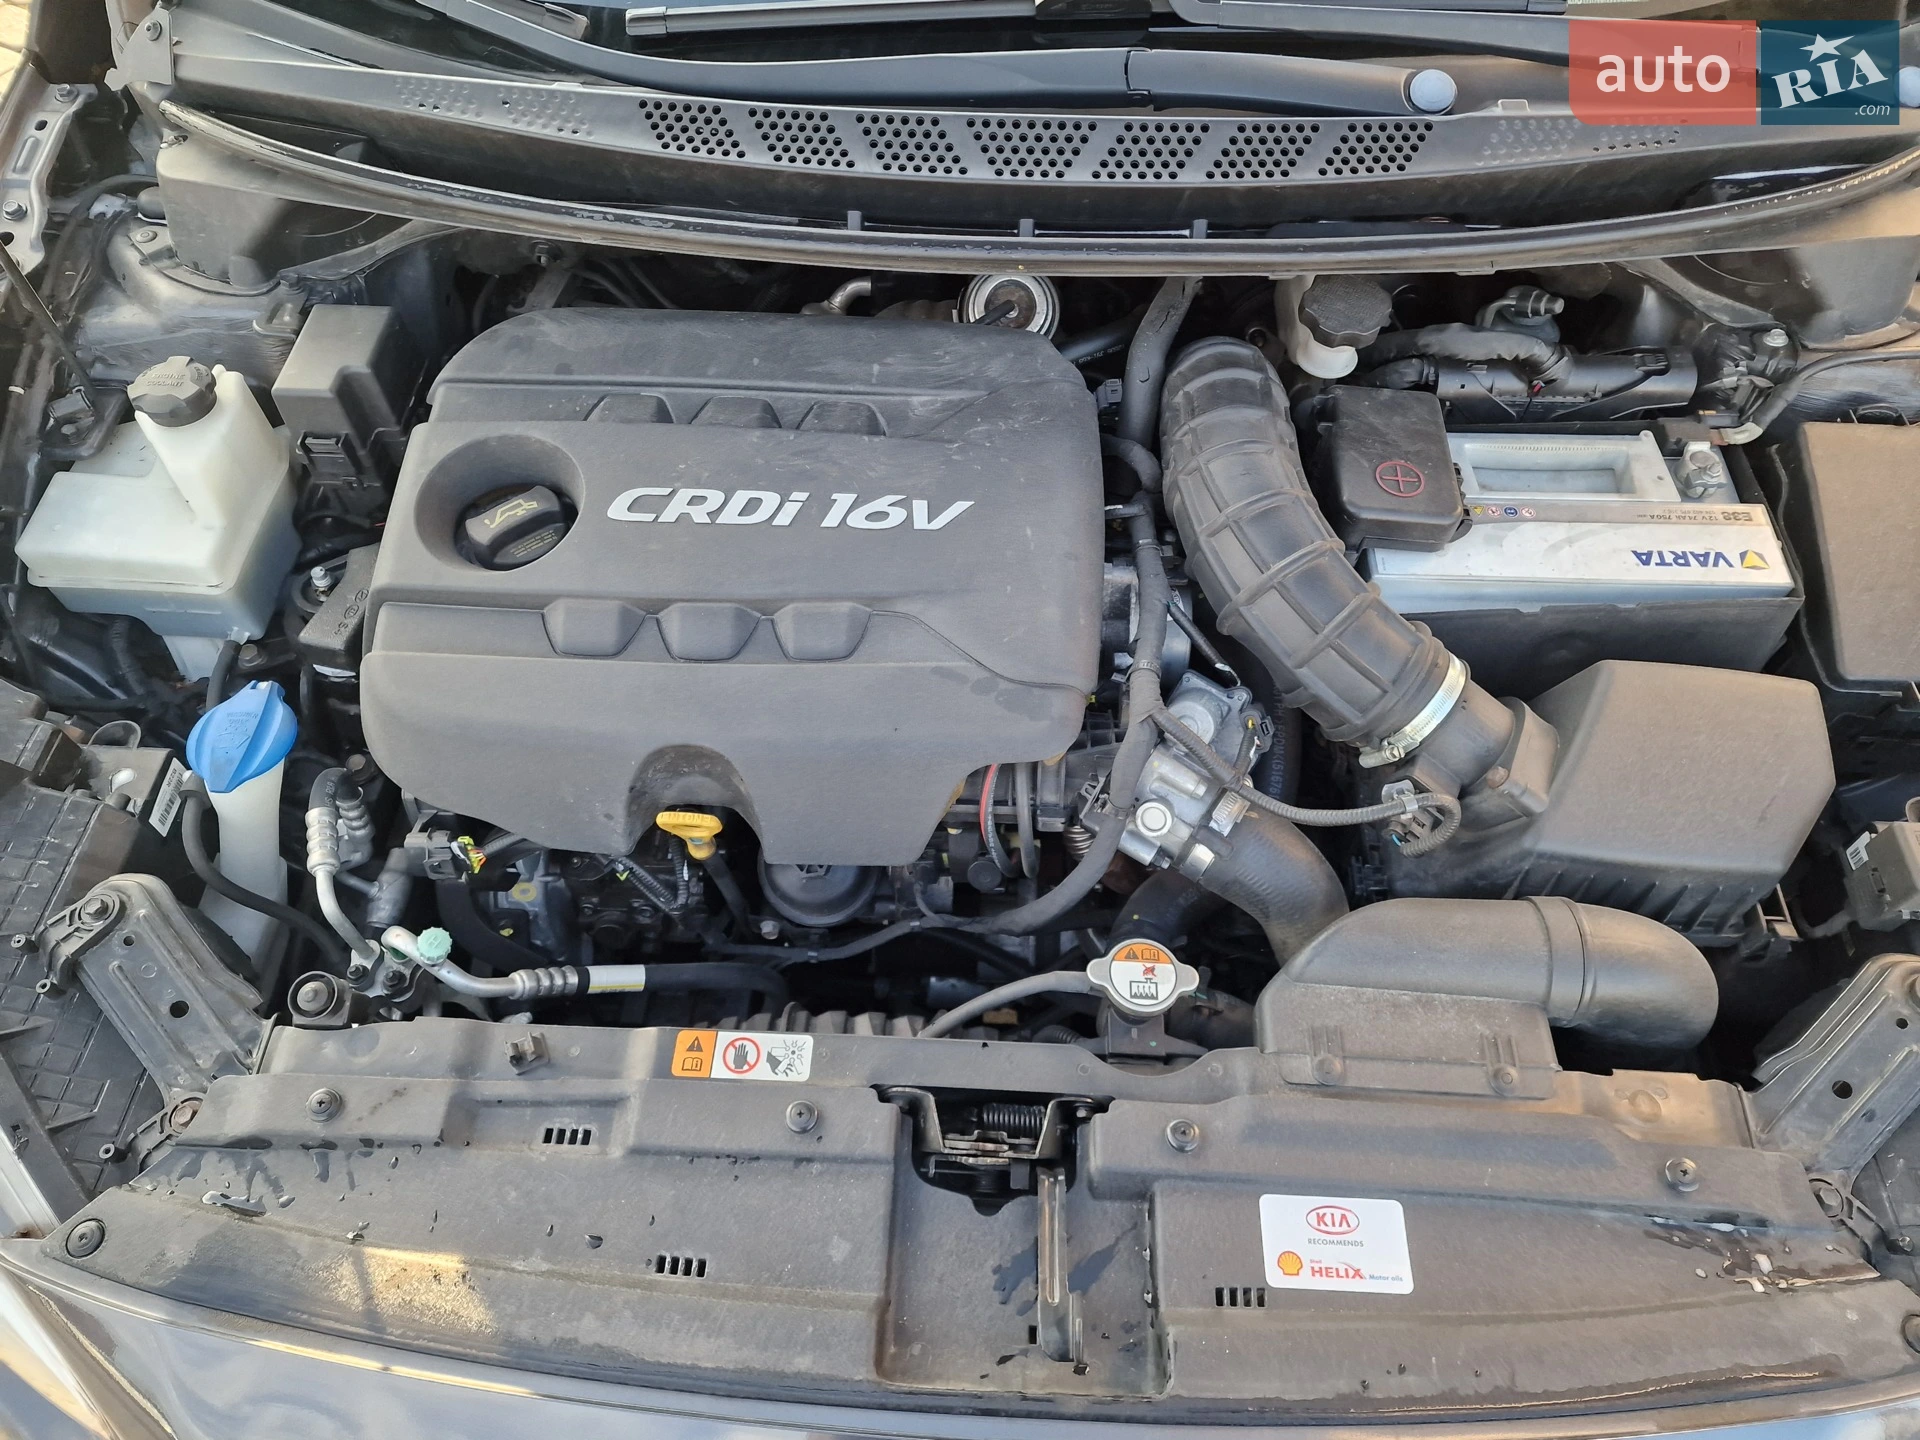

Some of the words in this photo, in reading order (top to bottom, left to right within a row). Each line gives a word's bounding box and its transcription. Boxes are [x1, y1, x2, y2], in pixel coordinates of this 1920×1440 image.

[606, 487, 810, 526] CRDi
[820, 493, 976, 530] 16V
[1720, 511, 1753, 522] E38
[1631, 549, 1735, 568] VARTA
[1315, 1212, 1352, 1228] KIA
[1307, 1238, 1364, 1247] RECOMMENDS
[1310, 1265, 1366, 1280] HELIX
